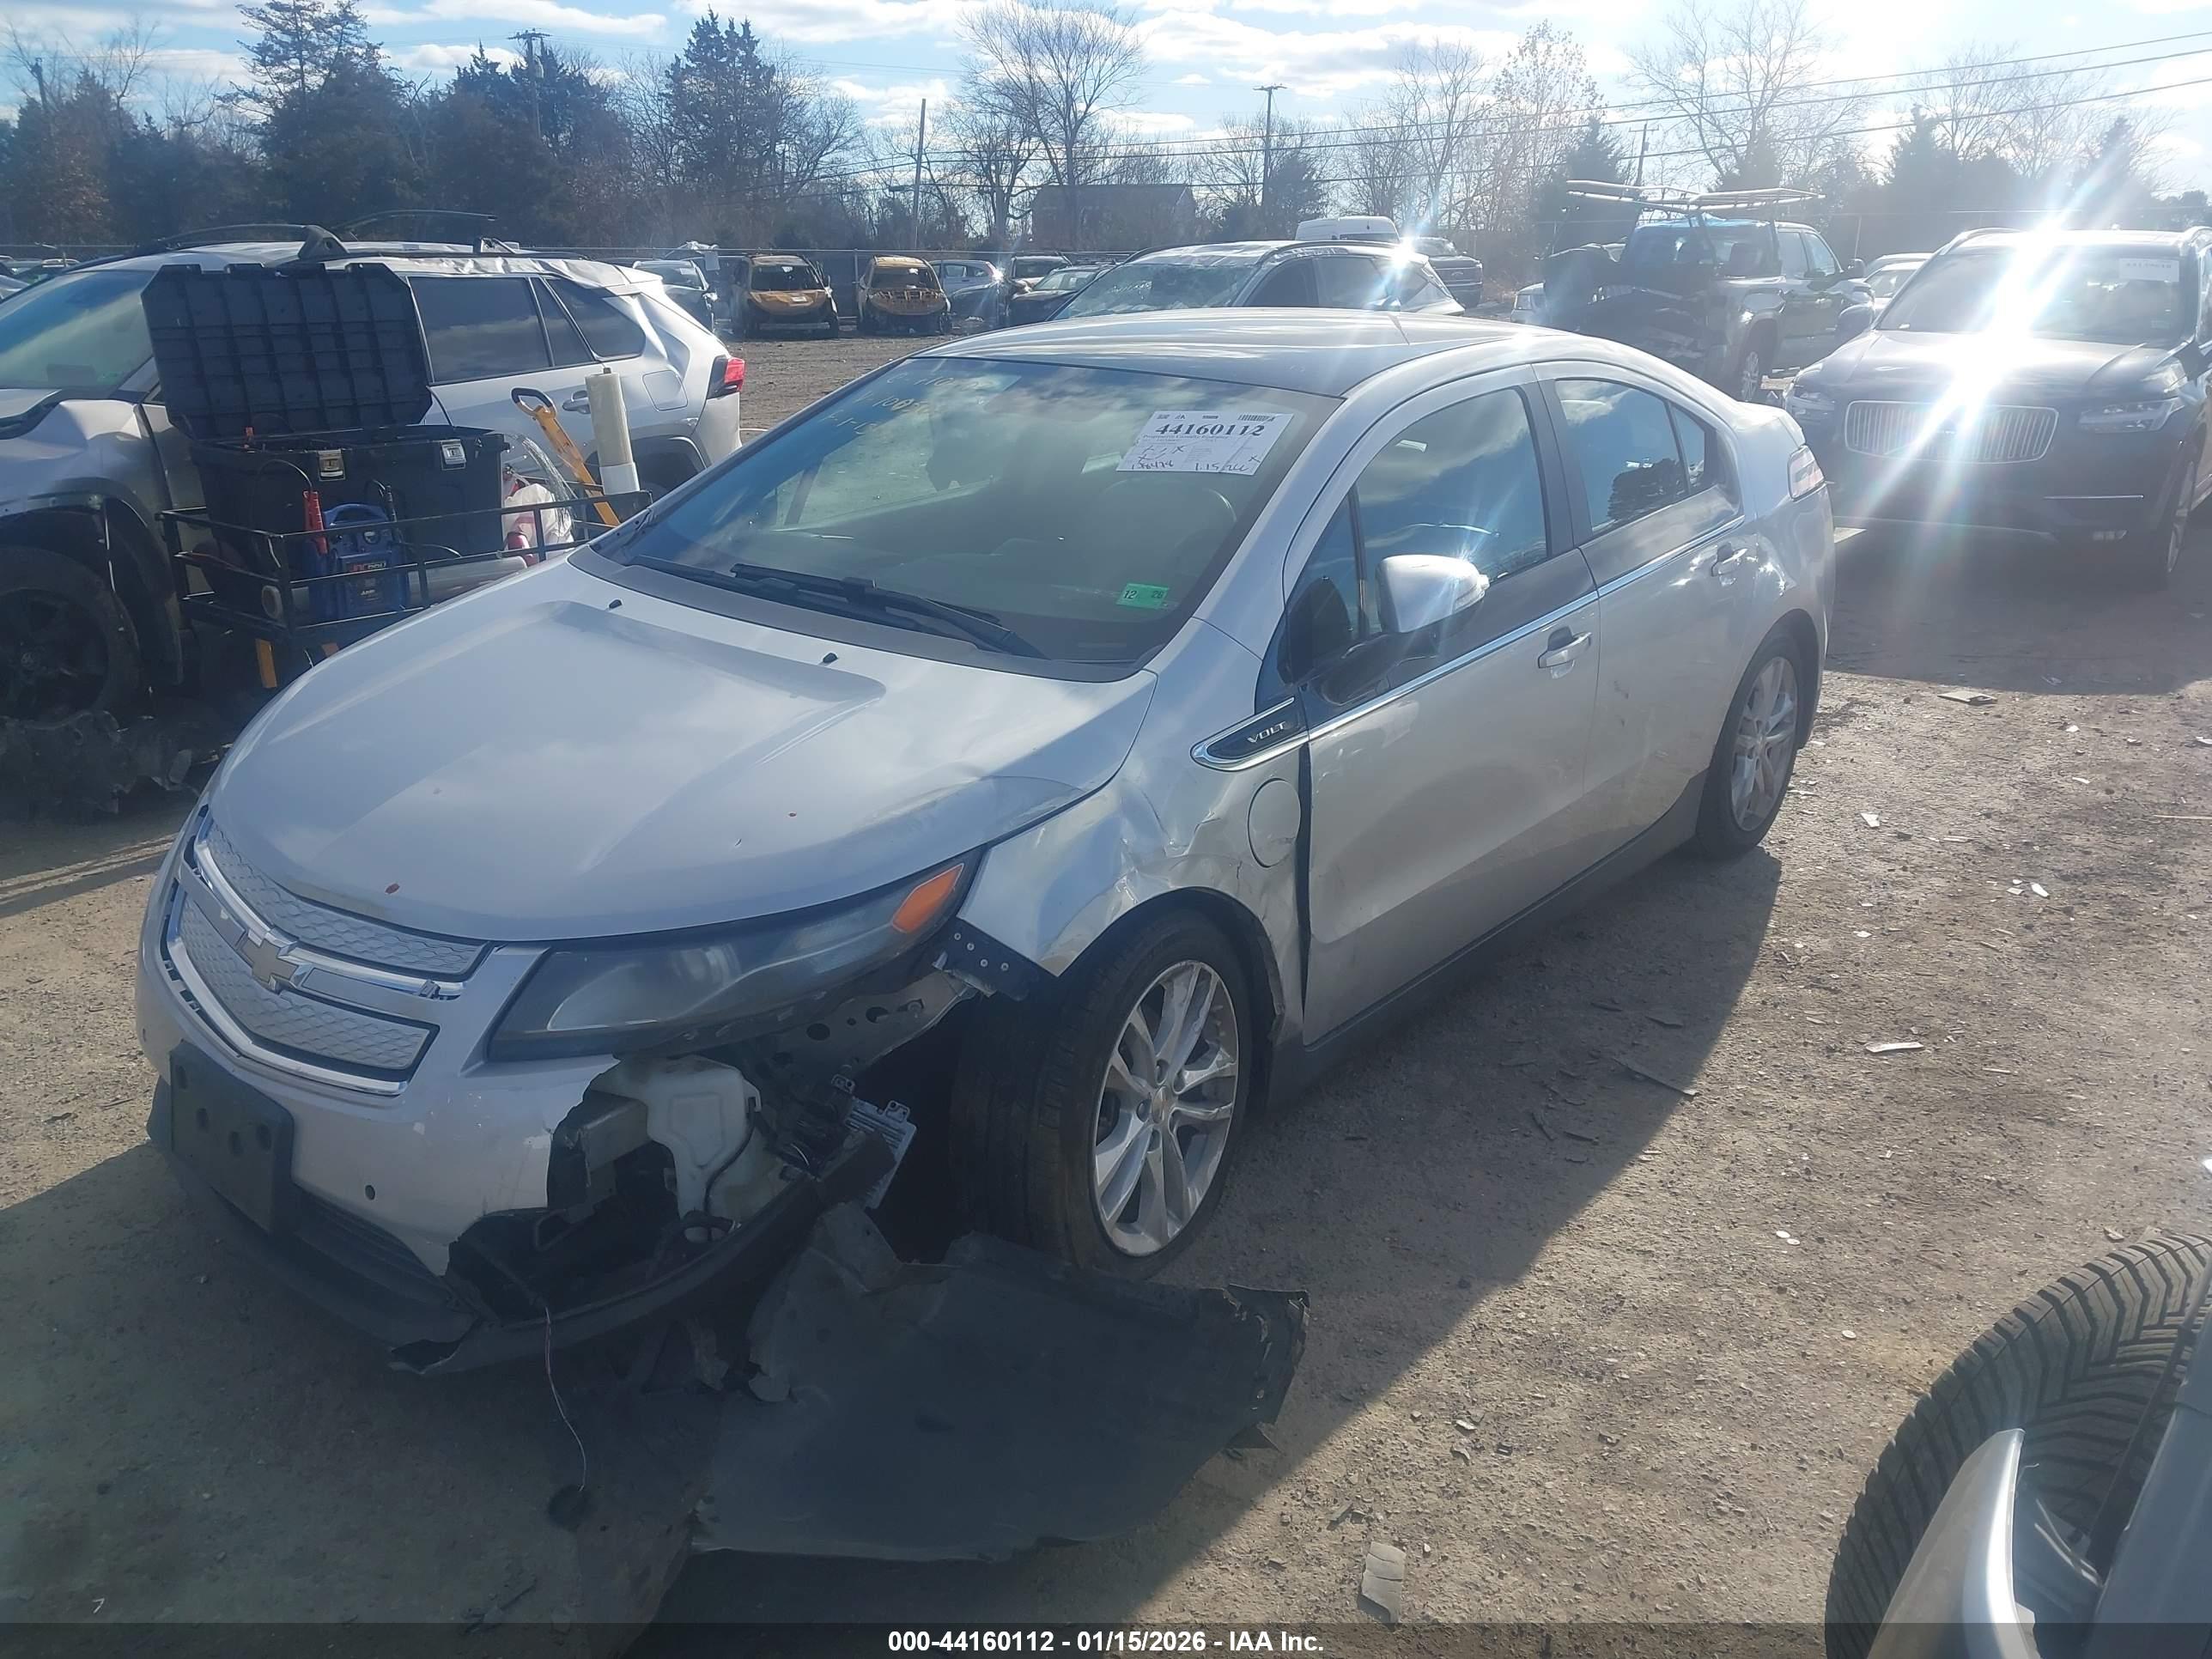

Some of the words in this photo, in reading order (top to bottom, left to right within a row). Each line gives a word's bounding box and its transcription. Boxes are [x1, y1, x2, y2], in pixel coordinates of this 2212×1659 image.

[1155, 422, 1265, 436] 44160112
[1123, 590, 1138, 599] 12
[1247, 720, 1286, 744] VOLT
